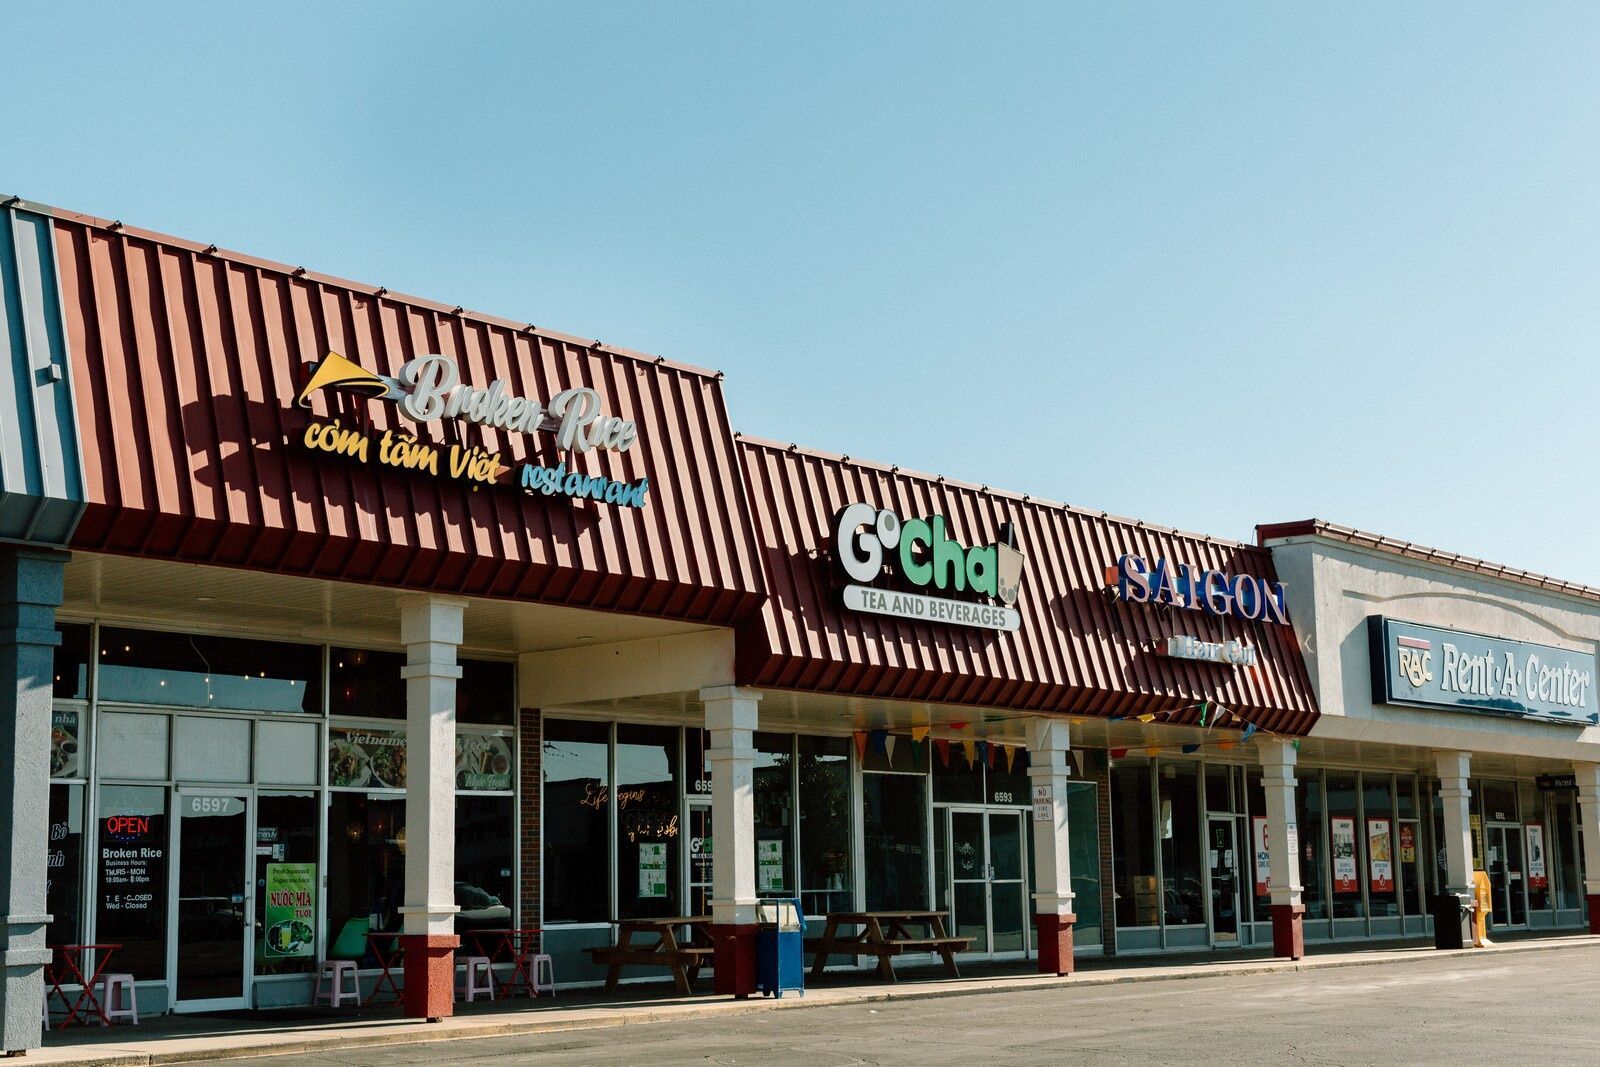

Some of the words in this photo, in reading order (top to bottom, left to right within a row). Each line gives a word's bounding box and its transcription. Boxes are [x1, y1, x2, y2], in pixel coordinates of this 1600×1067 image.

[400, 354, 545, 434] Broken
[549, 387, 638, 452] Rice
[521, 462, 649, 508] restaurant
[1118, 553, 1291, 626] SAIGON
[861, 590, 888, 611] TEA
[892, 597, 925, 616] AND
[929, 603, 1006, 628] BEVERAGES
[1398, 648, 1433, 688] RAC
[344, 731, 407, 747] Vietname
[695, 780, 712, 792] 659
[1038, 788, 1047, 797] NO
[191, 797, 230, 812] 6597
[617, 786, 646, 810] egins
[994, 792, 1013, 803] 6593
[107, 817, 149, 833] OPEN
[102, 848, 138, 858] Broken
[140, 848, 162, 858] Rice
[1257, 852, 1270, 860] MON
[105, 868, 126, 876] THURS
[106, 902, 120, 910] Wed
